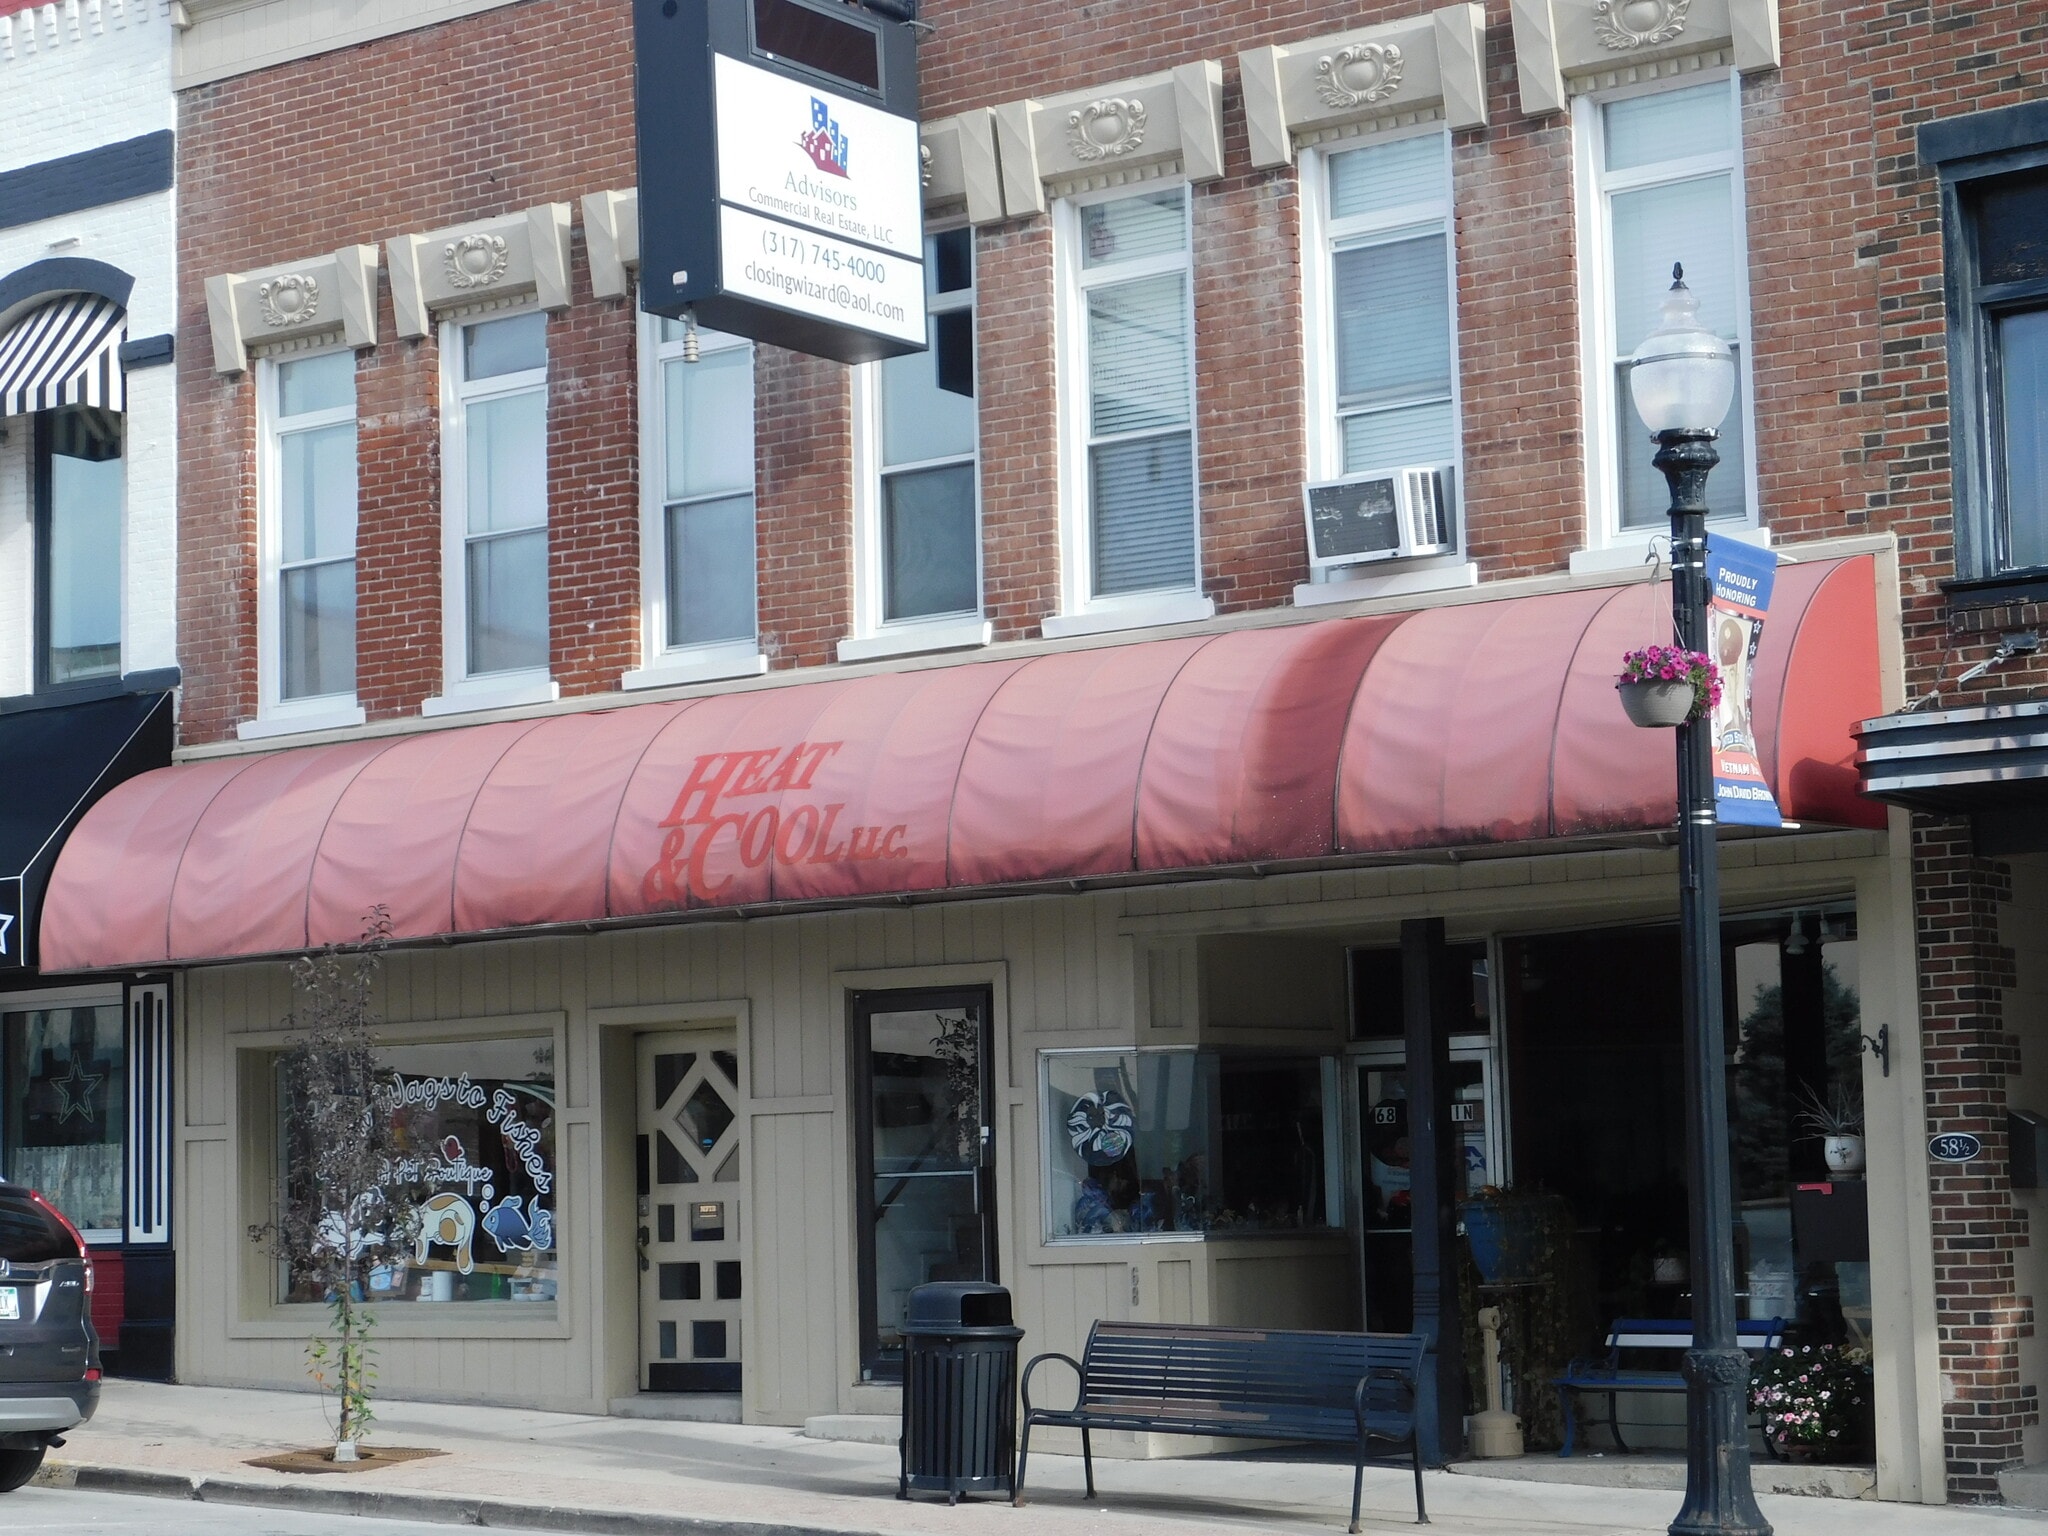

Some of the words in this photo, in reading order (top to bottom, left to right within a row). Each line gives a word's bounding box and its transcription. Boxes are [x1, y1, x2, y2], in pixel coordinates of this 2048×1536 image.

[784, 171, 857, 211] Advisors
[748, 186, 811, 219] Commercial
[814, 206, 835, 227] Real
[838, 213, 871, 240] Estate,
[873, 224, 894, 244] LLC
[762, 230, 805, 265] (317)
[811, 243, 886, 284] 745-4000
[744, 260, 905, 322] closingwizard@aol.com
[1715, 582, 1757, 607] HONORING
[1718, 567, 1758, 590] PROUDLY
[657, 740, 844, 829] HEAT
[1717, 783, 1734, 799] JOHN
[1733, 785, 1752, 800] DAVID
[457, 1072, 487, 1109] to
[486, 1088, 552, 1193] Fishes
[1376, 1108, 1396, 1123] 68
